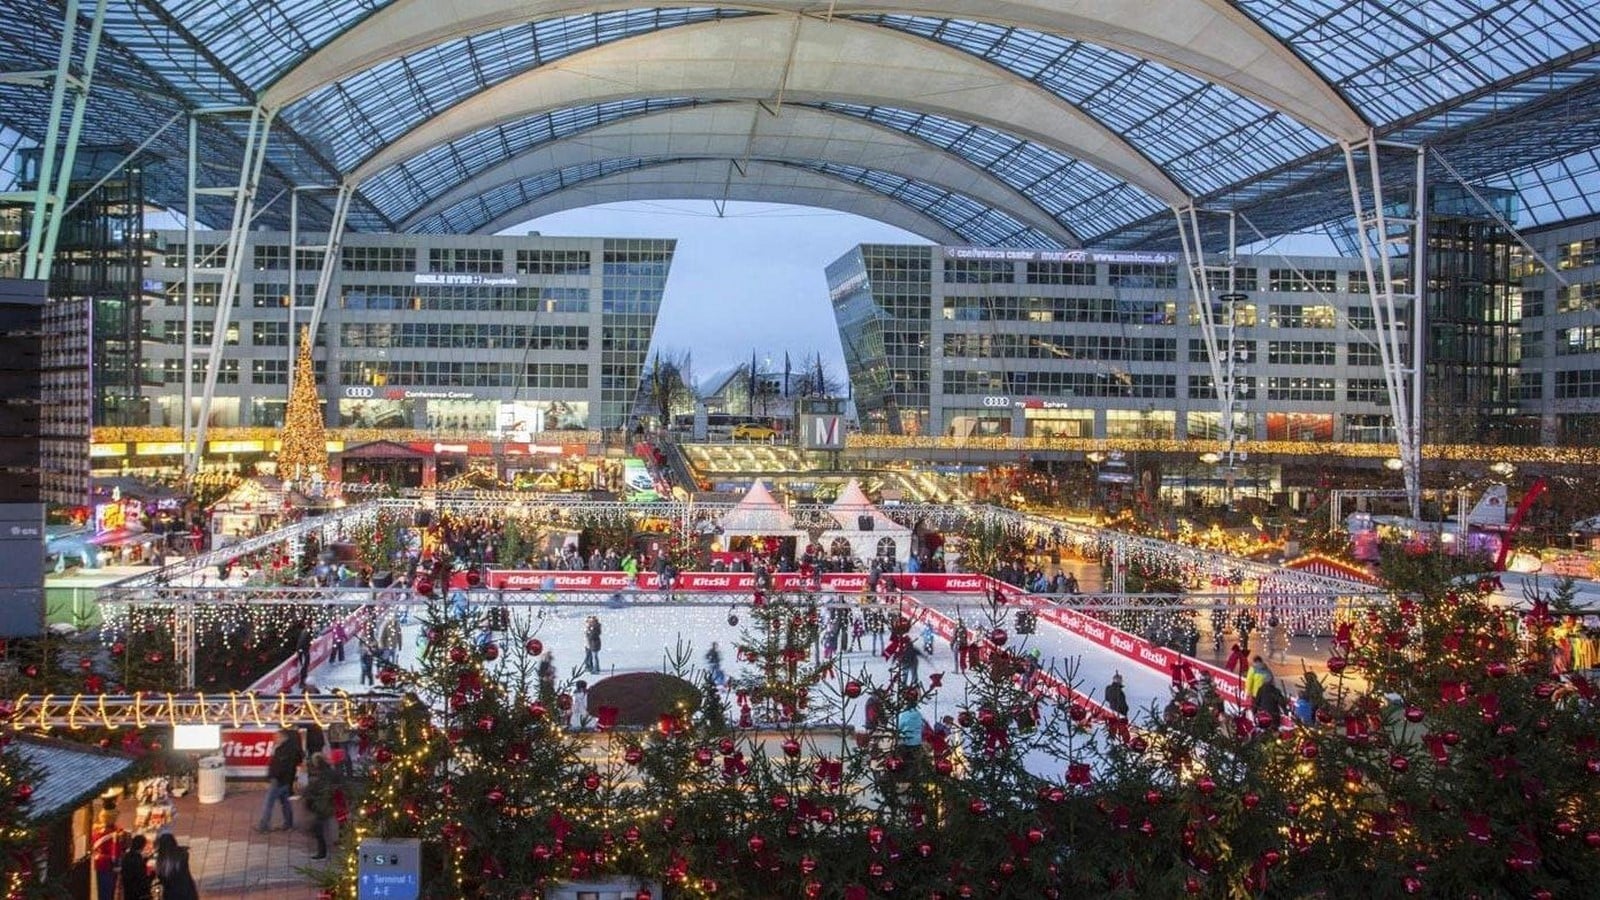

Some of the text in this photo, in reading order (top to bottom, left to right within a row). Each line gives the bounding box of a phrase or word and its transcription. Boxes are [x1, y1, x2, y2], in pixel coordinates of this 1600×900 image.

[957, 249, 1005, 258] conference
[1006, 251, 1034, 259] center
[404, 390, 447, 398] Conference
[815, 416, 839, 445] M
[554, 575, 592, 586] KitzSki
[692, 576, 731, 587] KitzSki
[830, 577, 867, 588] KitzSki
[946, 578, 981, 589] KitzSki
[1140, 646, 1168, 667] KitzSki
[375, 854, 384, 865] S
[374, 873, 406, 884] Terminal
